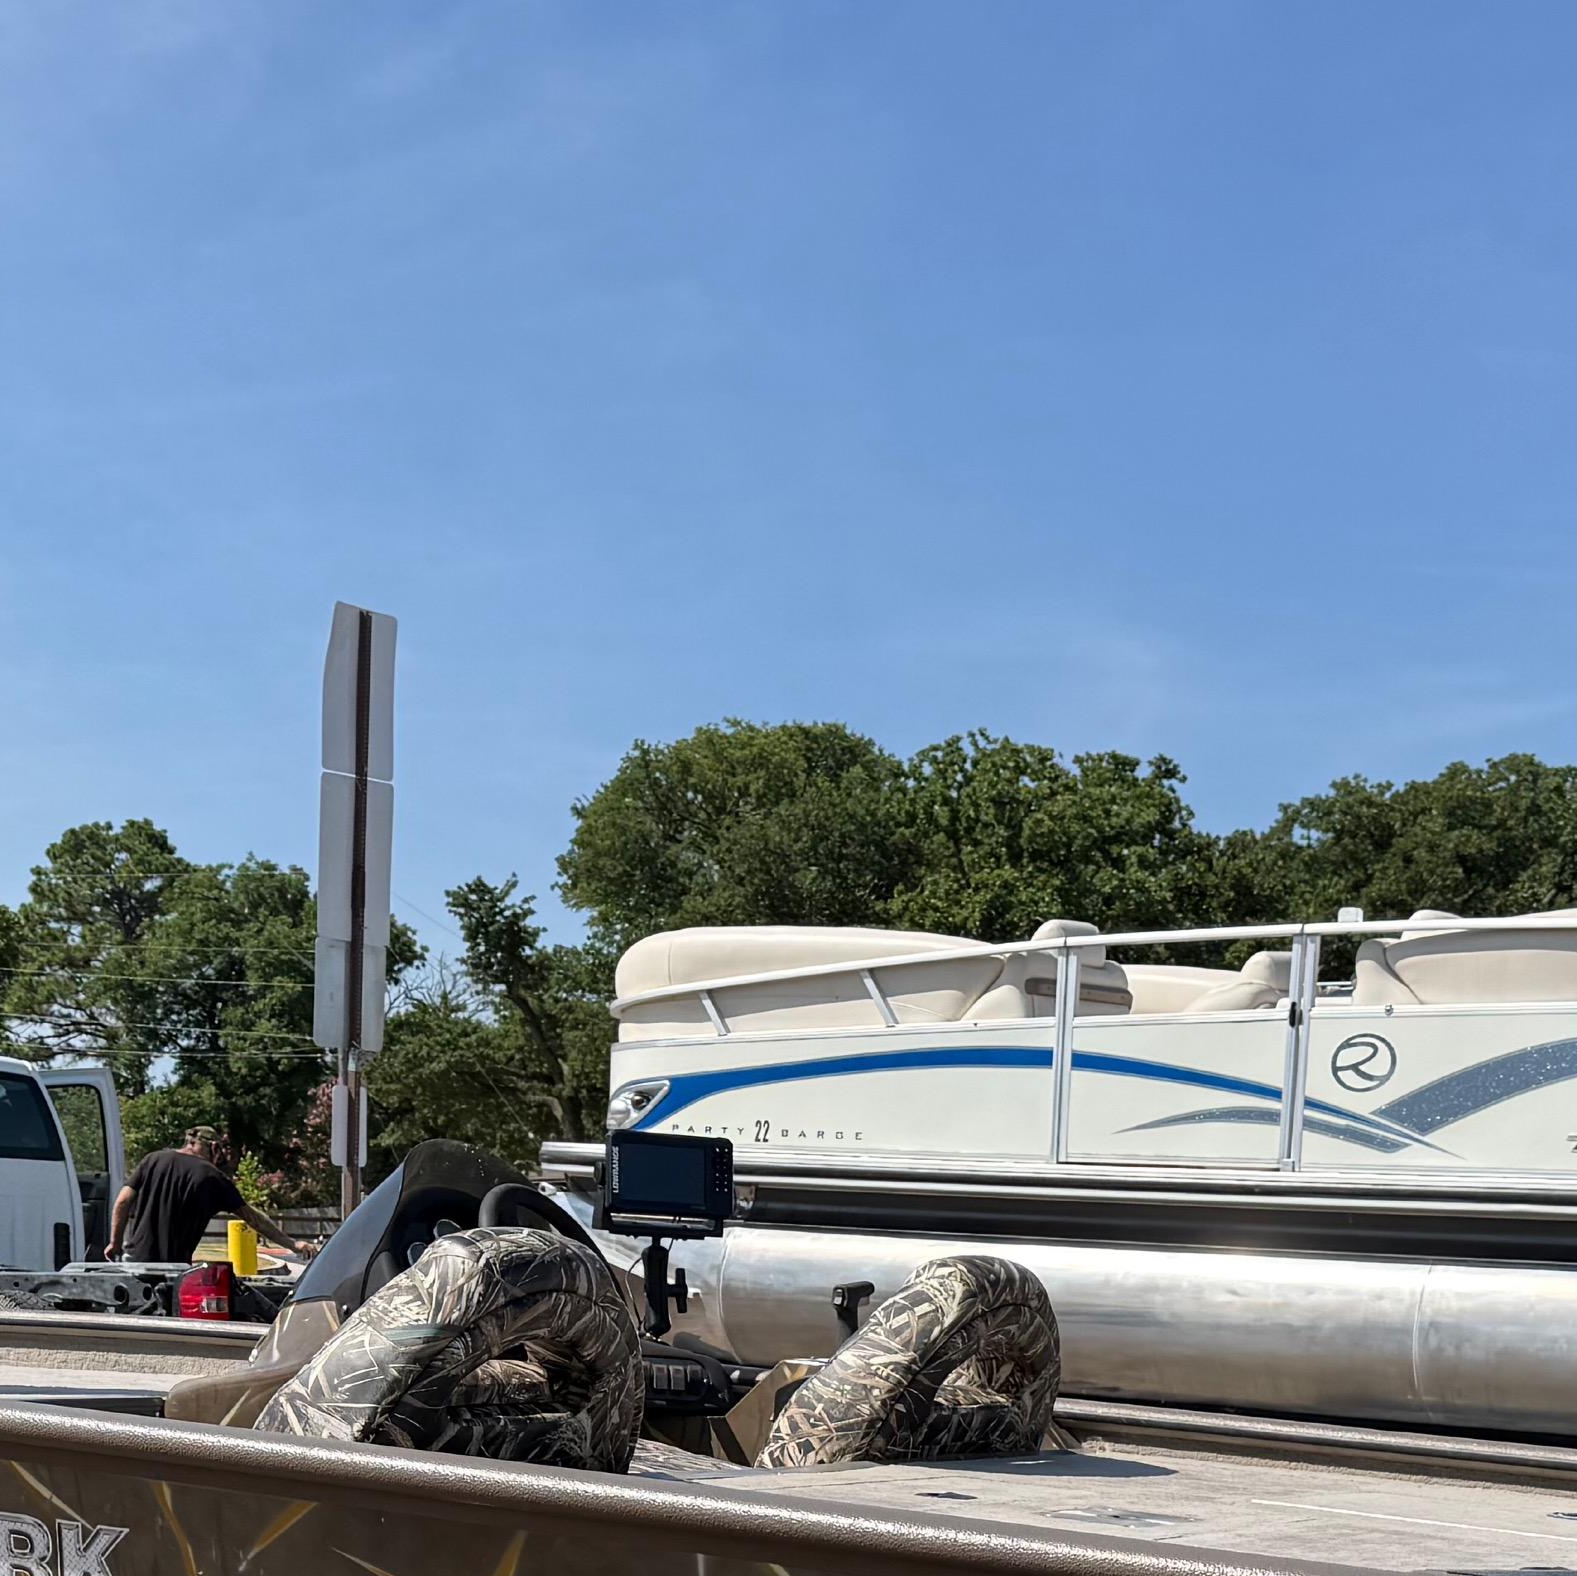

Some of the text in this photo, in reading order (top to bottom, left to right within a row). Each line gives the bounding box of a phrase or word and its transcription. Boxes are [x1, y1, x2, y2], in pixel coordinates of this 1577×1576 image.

[672, 1119, 863, 1143] PARTY 22 BARGE
